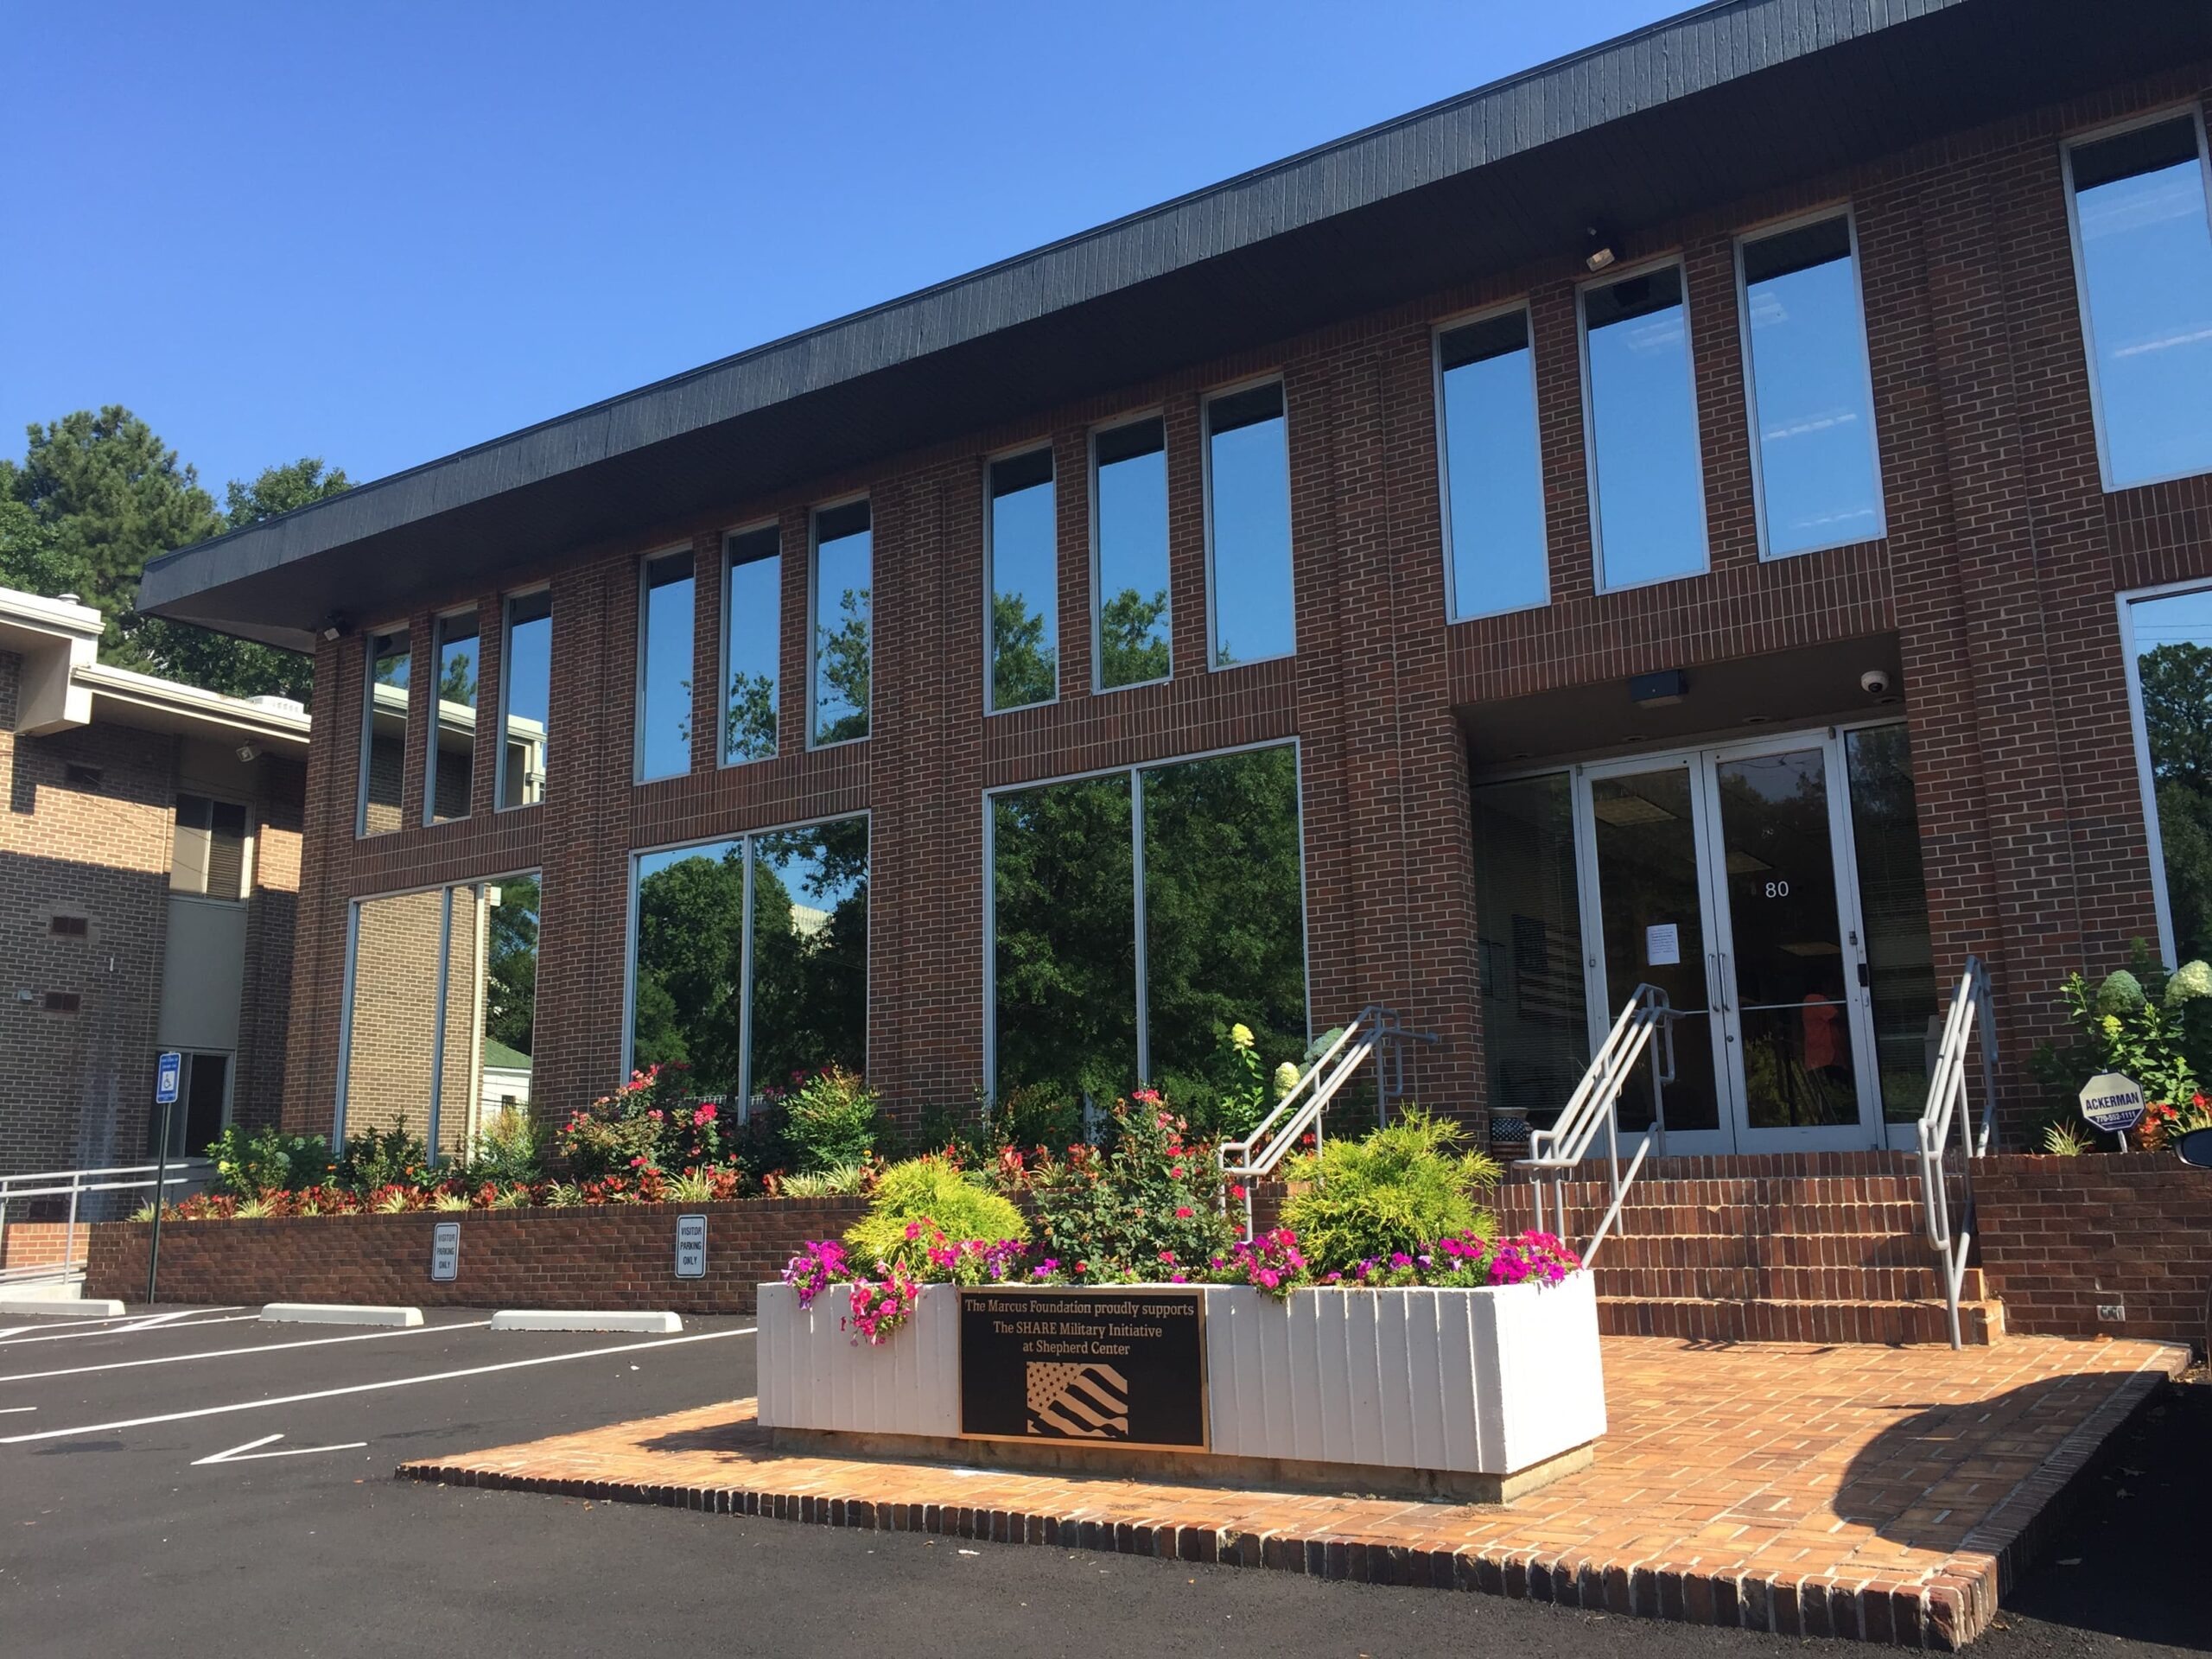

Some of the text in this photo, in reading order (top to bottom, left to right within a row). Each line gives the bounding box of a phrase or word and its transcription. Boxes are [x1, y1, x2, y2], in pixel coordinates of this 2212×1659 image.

[1765, 880, 1789, 899] 80
[2086, 1092, 2139, 1110] ACKERMAN
[680, 1242, 701, 1250] PARKING
[683, 1256, 697, 1265] ONLY
[965, 1300, 1194, 1319] The Marcus Foundation proudly supports
[994, 1321, 1162, 1338] The SHARE Military Initiative
[1023, 1340, 1130, 1356] at Shepherd Center
